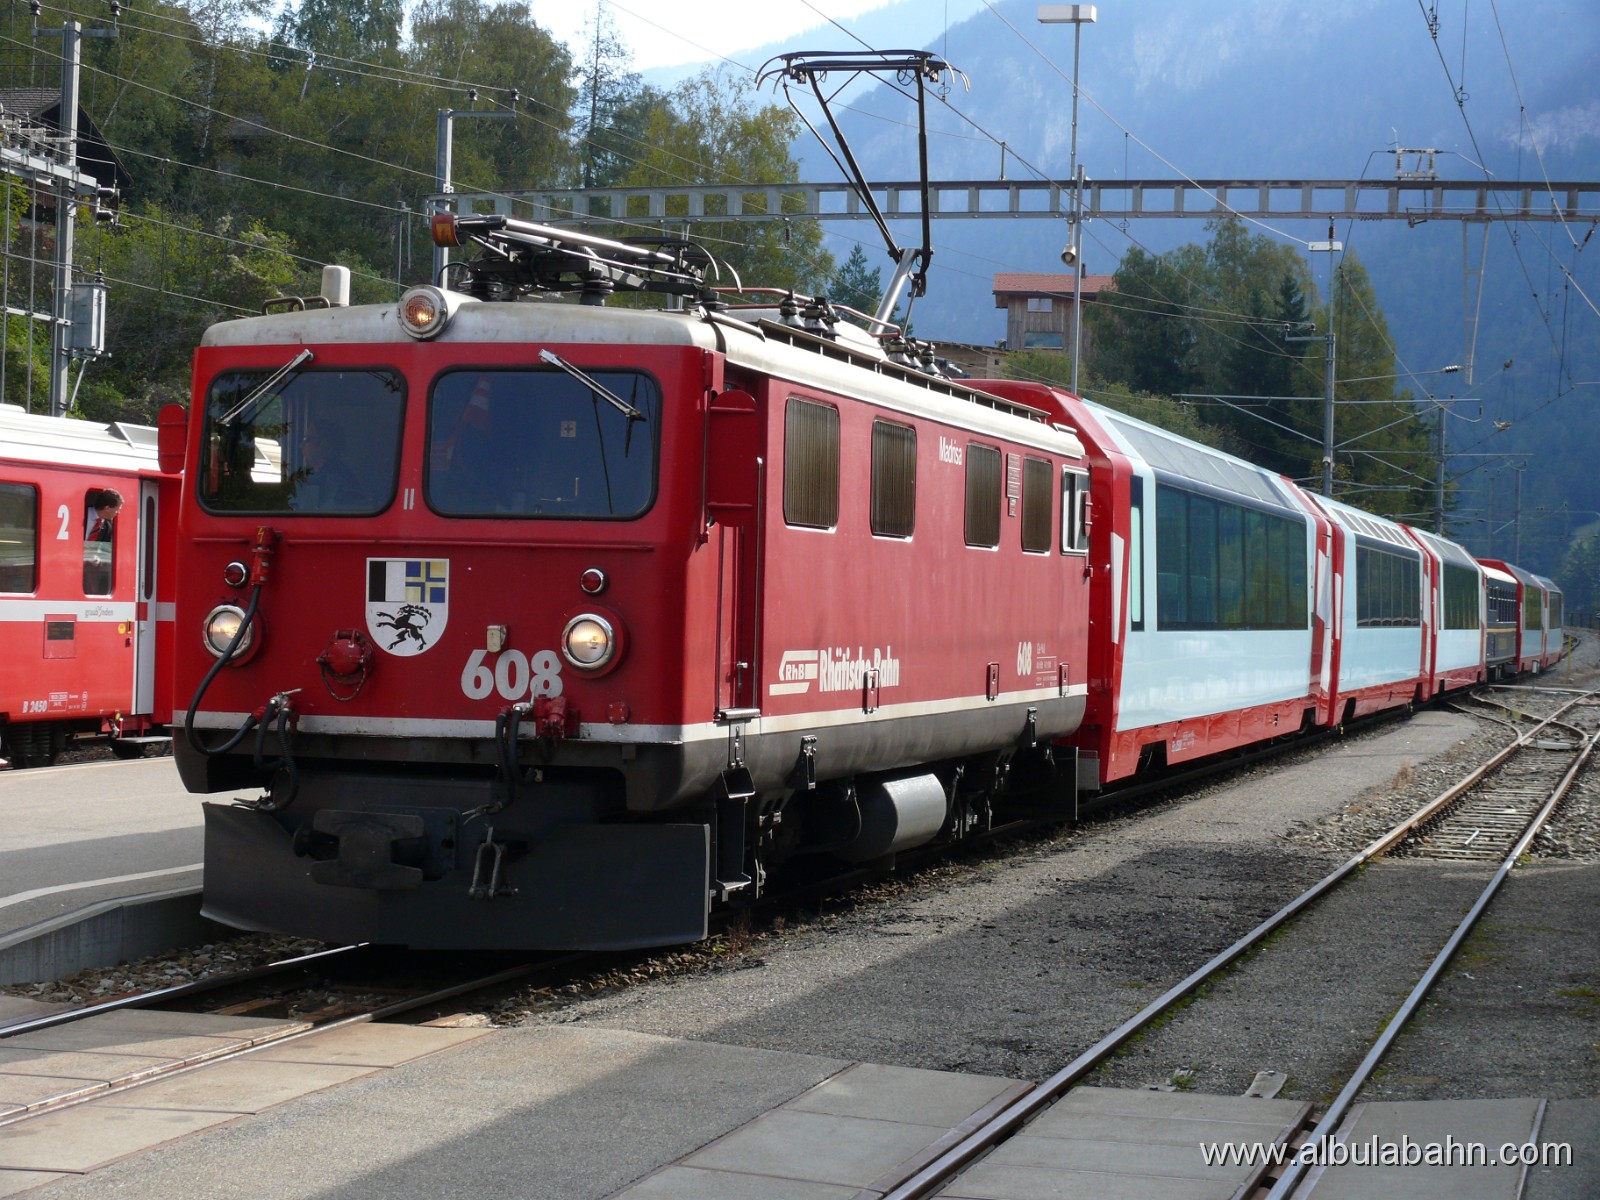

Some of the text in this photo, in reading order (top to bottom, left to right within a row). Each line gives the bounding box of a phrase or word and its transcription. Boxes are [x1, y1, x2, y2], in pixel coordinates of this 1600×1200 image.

[939, 436, 963, 466] Madrisa
[56, 504, 70, 540] 2
[461, 648, 563, 701] 608
[785, 663, 806, 680] RhB
[872, 645, 900, 689] Bahn
[1016, 641, 1032, 676] 608
[22, 700, 48, 713] B 2450
